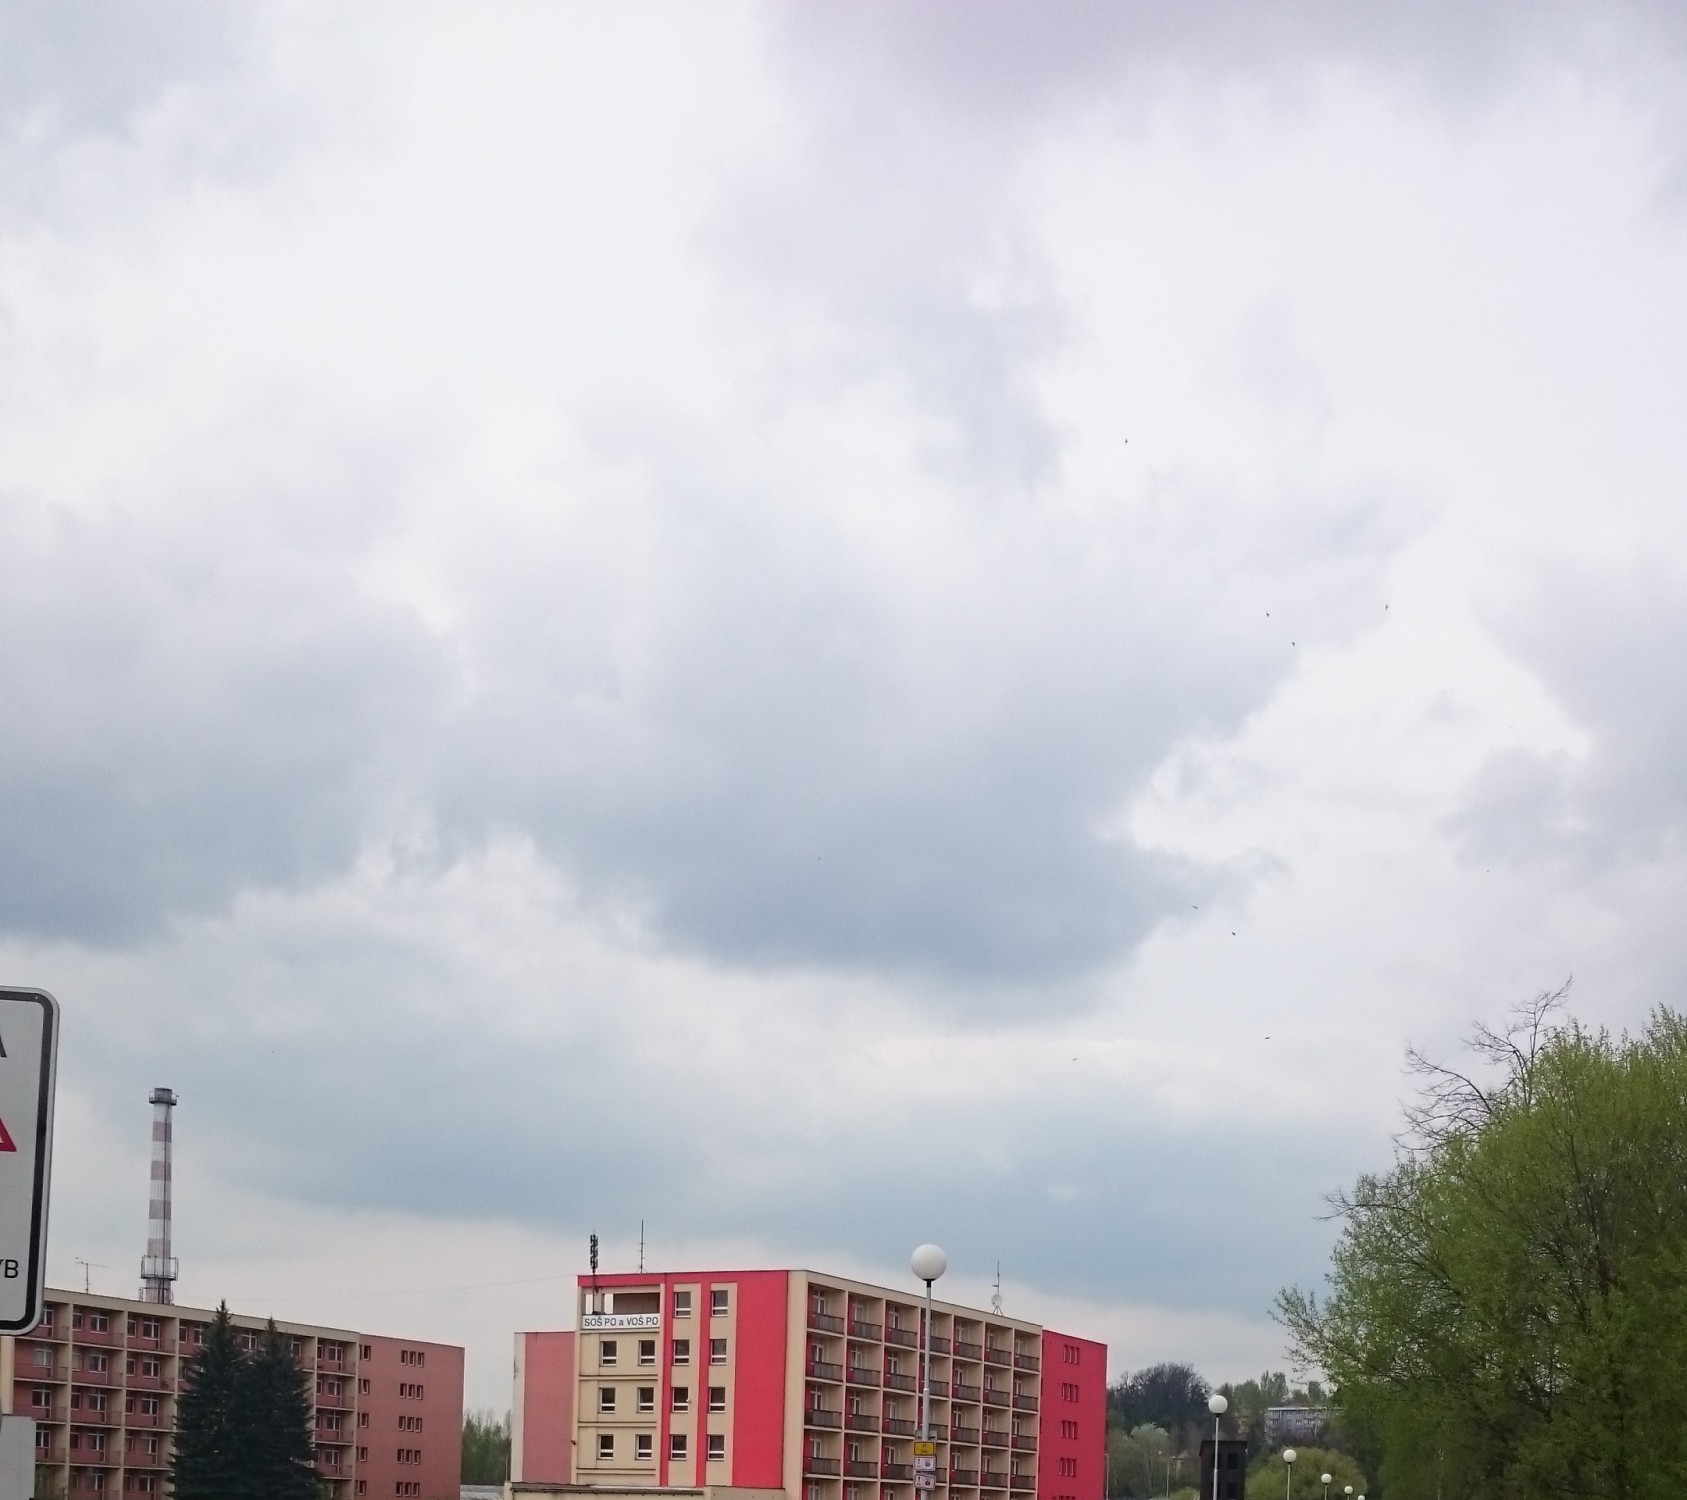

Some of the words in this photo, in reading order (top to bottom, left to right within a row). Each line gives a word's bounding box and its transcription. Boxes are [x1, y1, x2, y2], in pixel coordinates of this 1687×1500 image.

[584, 1316, 602, 1327] SOŠ
[604, 1317, 617, 1326] PO
[626, 1315, 644, 1326] VOŠ
[645, 1316, 659, 1326] PO
